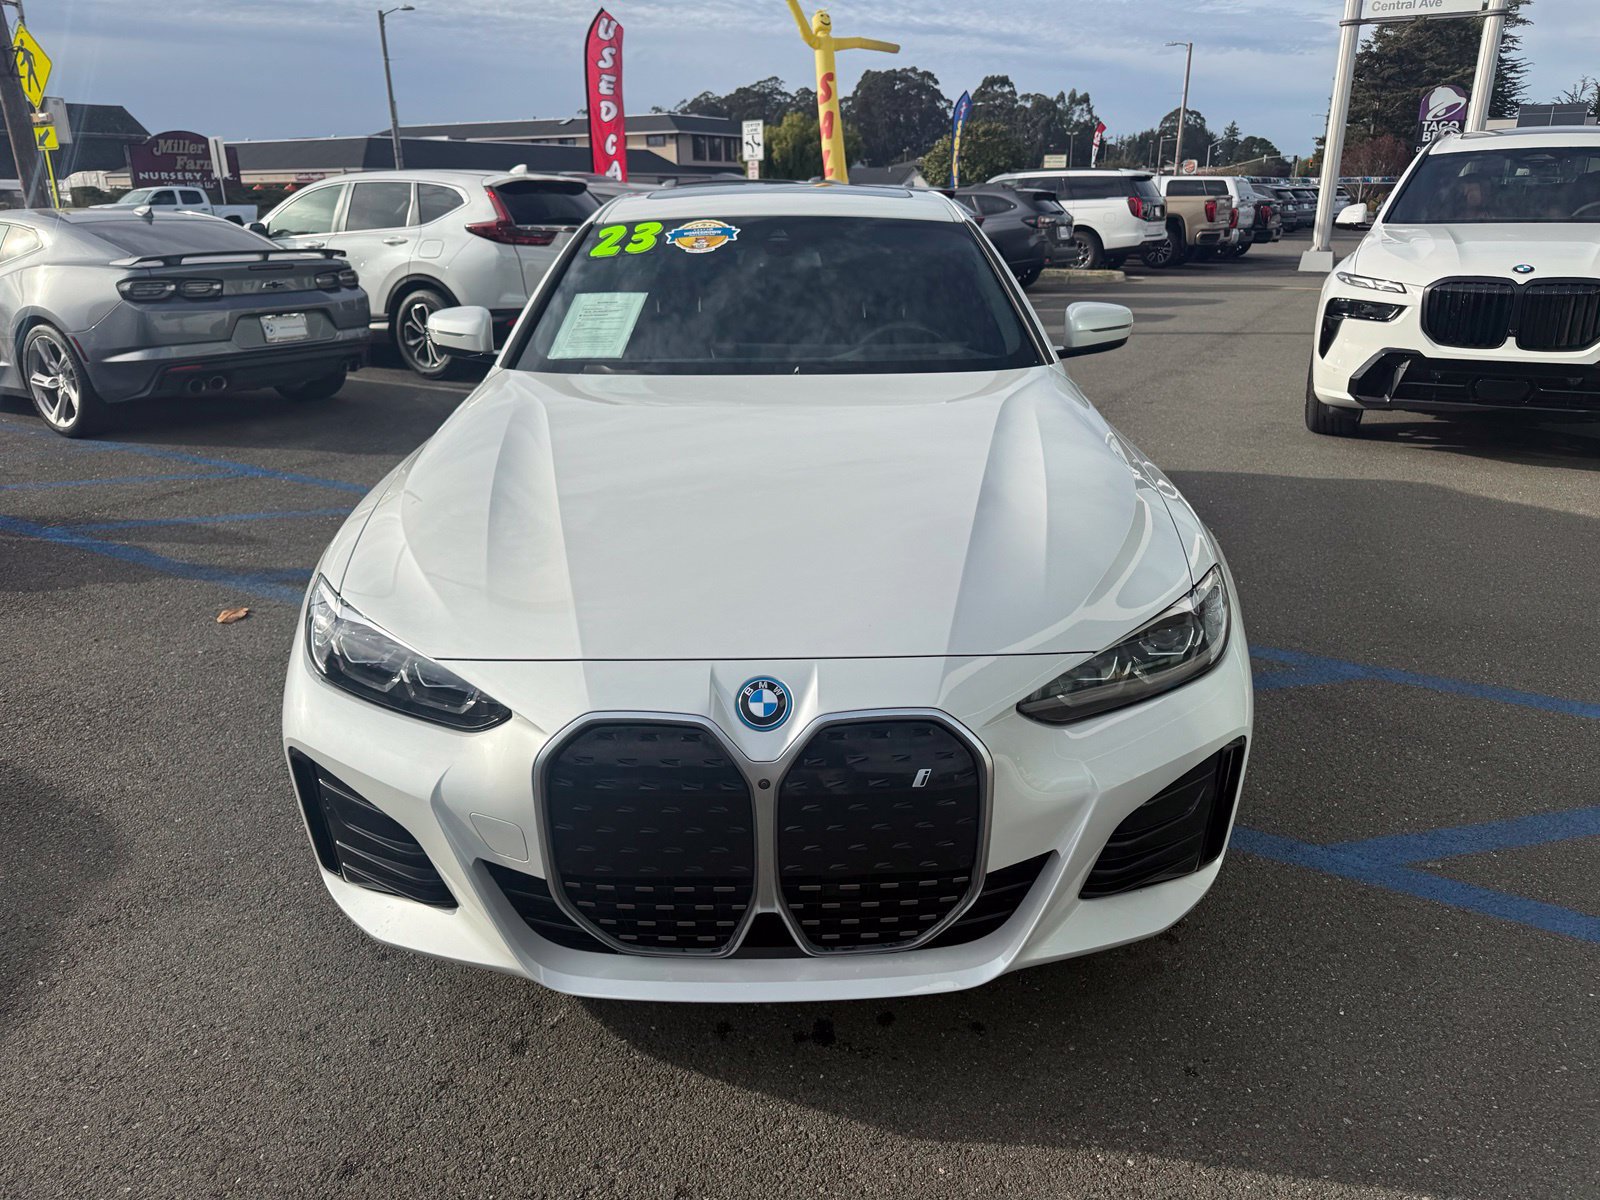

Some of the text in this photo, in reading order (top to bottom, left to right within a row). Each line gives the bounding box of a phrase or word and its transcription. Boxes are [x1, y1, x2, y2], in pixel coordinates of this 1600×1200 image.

[1371, 0, 1443, 12] Central Ave
[597, 17, 618, 123] USED
[152, 139, 206, 156] Miller
[589, 221, 664, 258] 23
[743, 680, 784, 697] BMW
